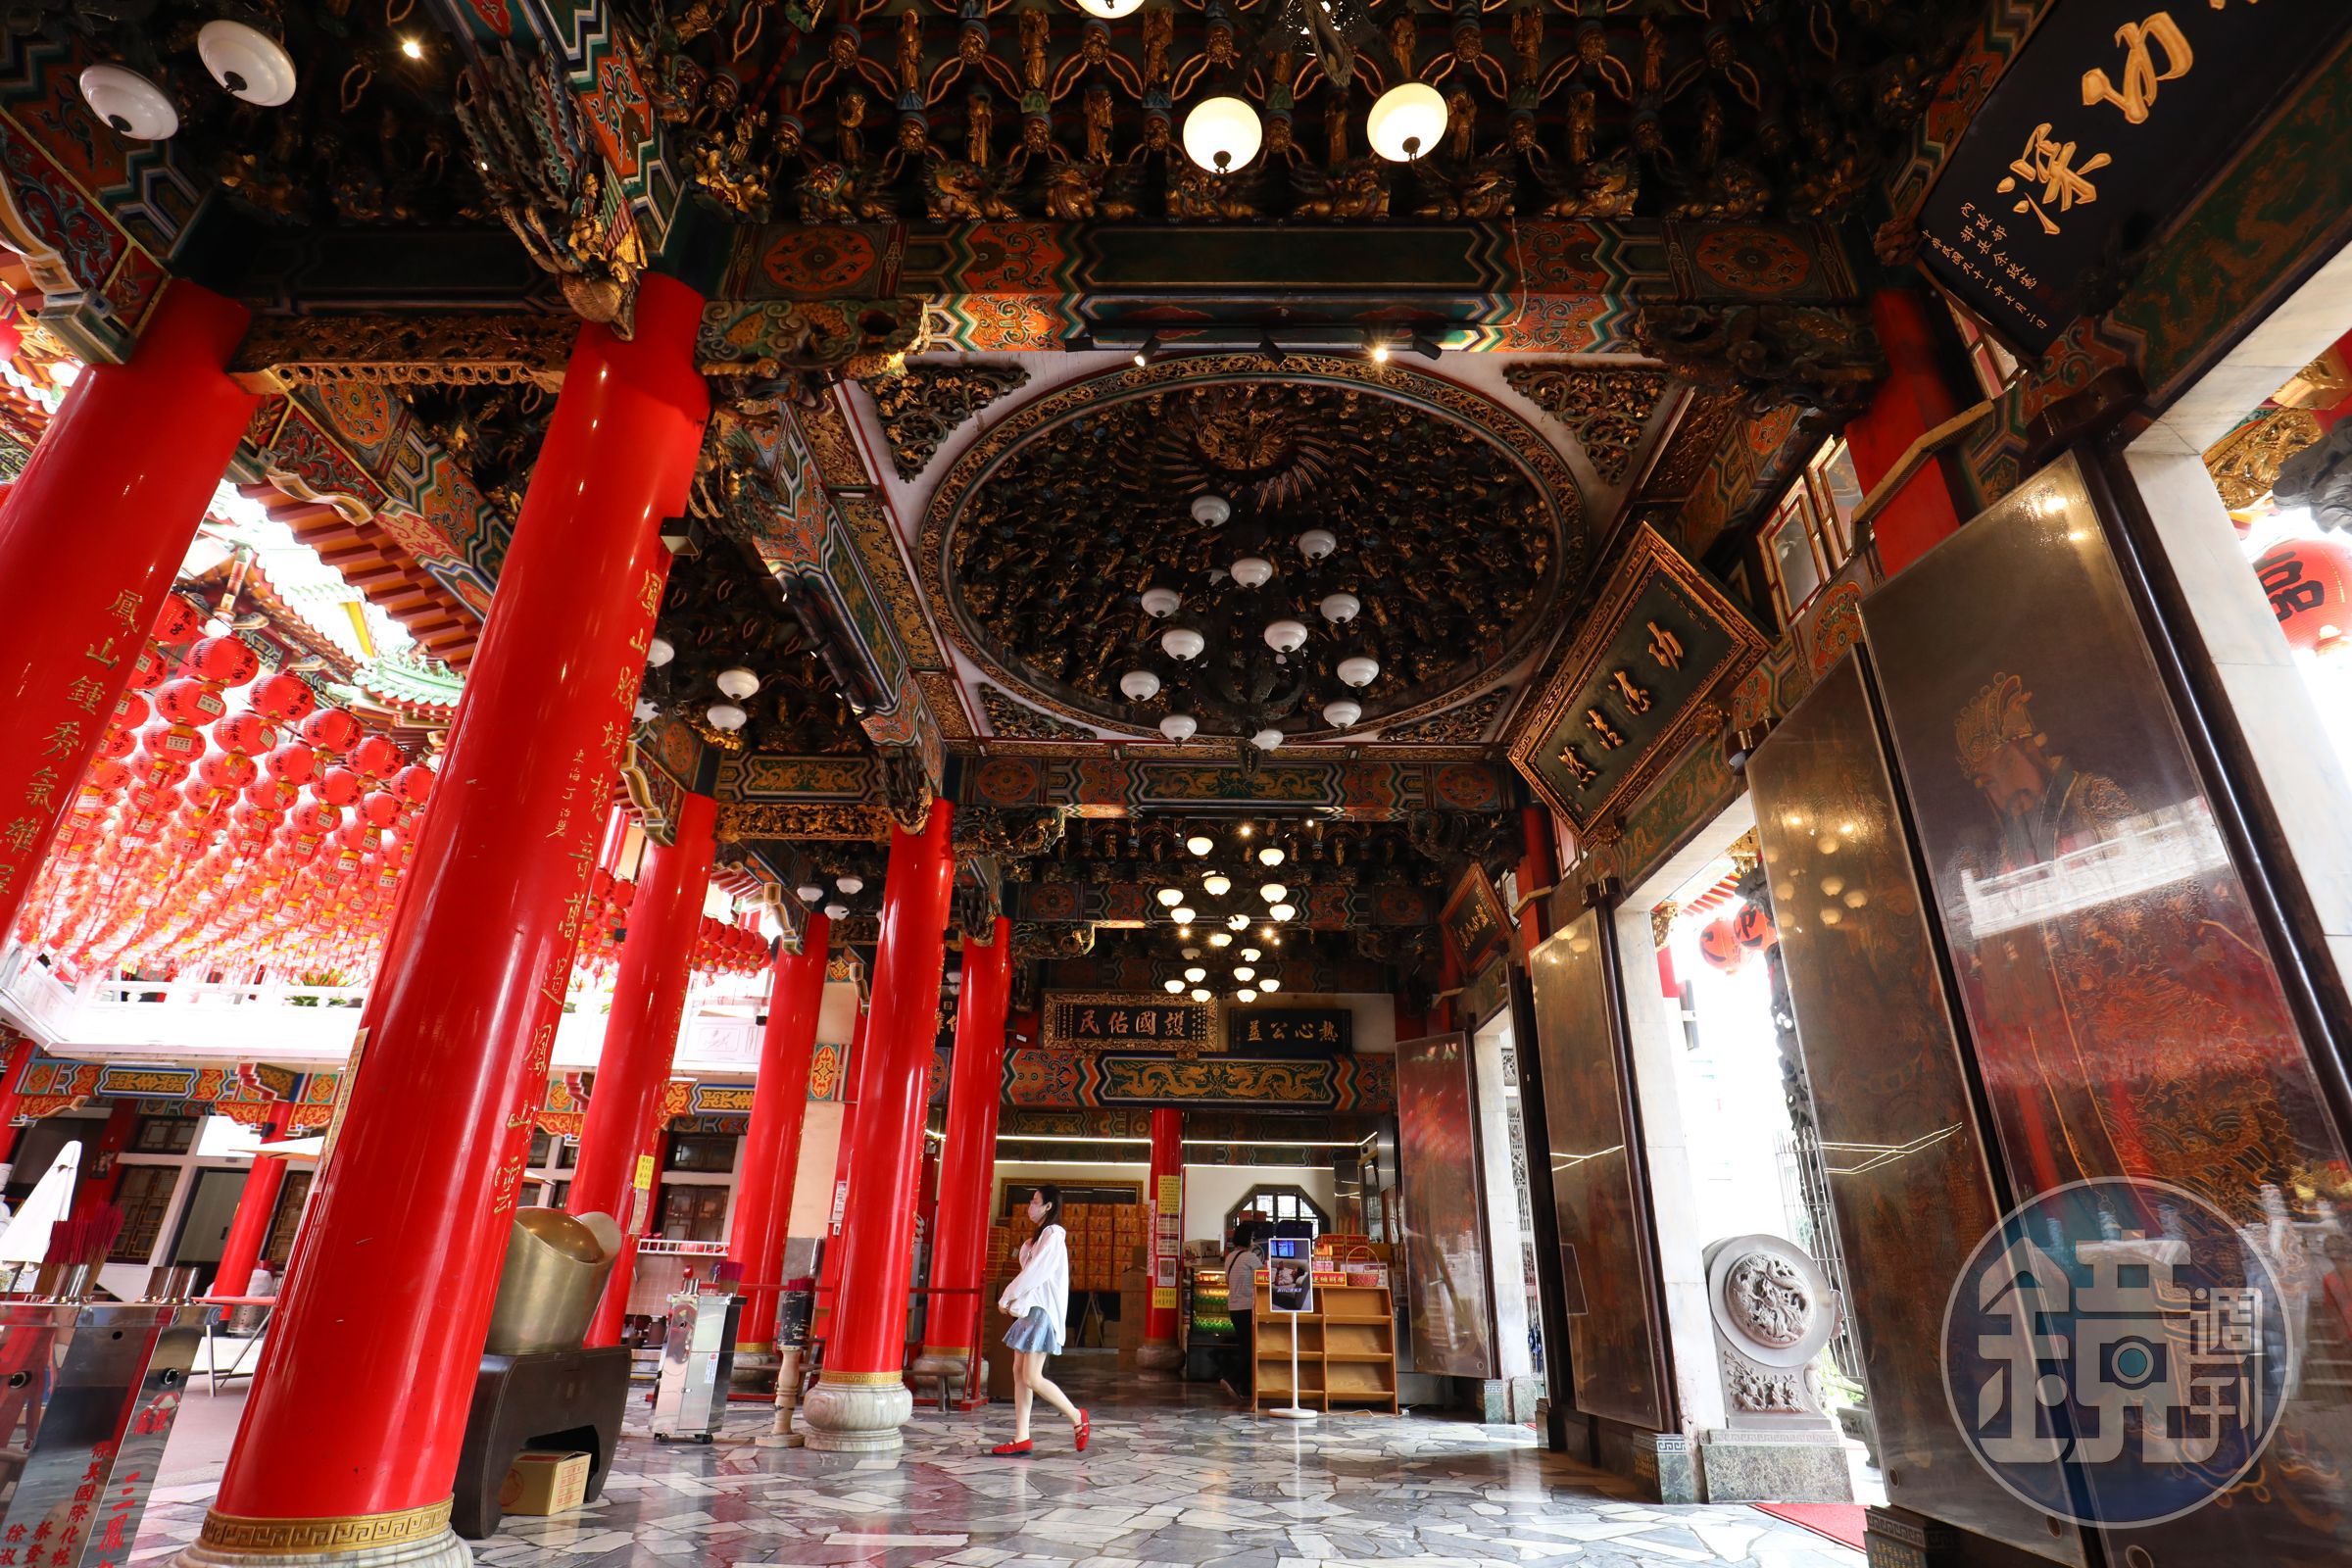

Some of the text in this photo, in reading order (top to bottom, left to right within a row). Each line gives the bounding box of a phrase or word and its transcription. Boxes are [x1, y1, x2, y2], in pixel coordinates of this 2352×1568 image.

[1996, 0, 2258, 234] 功深
[1960, 224, 2038, 291] 部長余政憲
[1078, 1008, 1187, 1038] 護國佑民
[1247, 1020, 1339, 1044] 熱心公益
[96, 1471, 141, 1568] 三鳳
